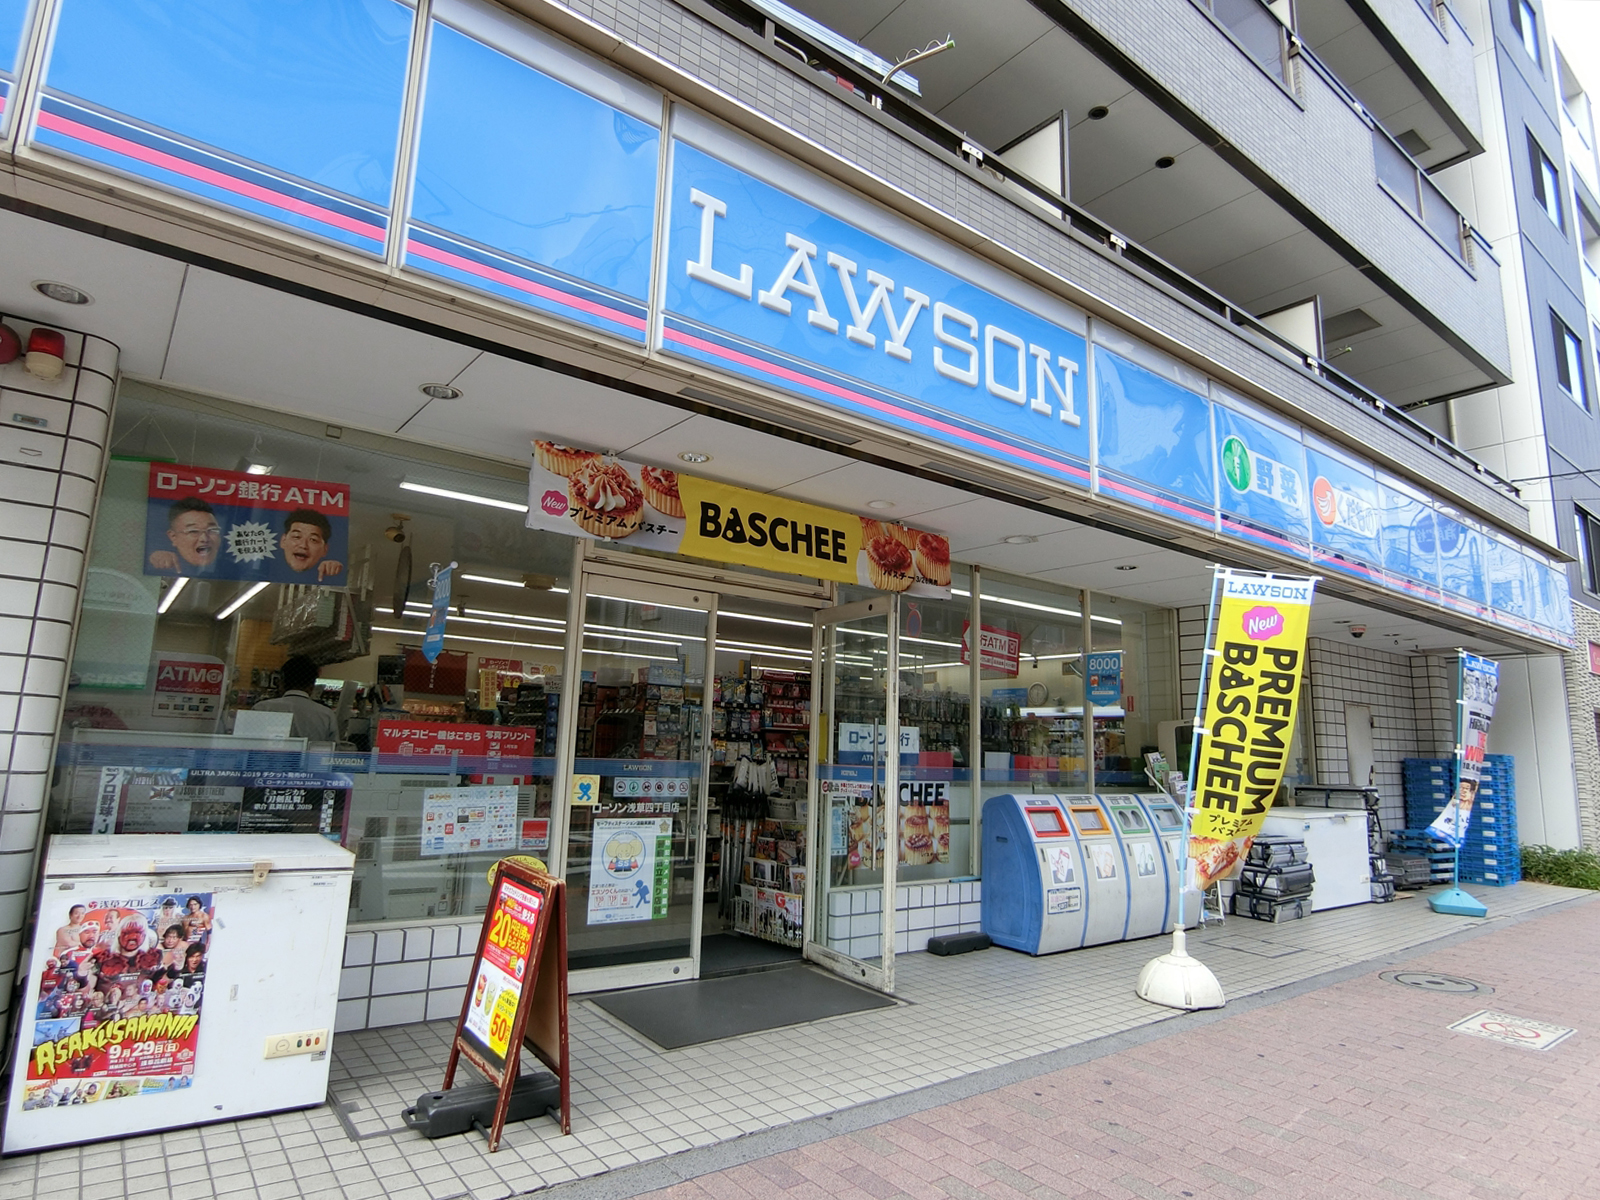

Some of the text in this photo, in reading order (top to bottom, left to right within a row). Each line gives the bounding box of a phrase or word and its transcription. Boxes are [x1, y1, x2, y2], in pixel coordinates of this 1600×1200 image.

[686, 187, 1080, 428] LAWSON
[1255, 456, 1298, 505] 野菜
[543, 496, 566, 511] New
[699, 501, 848, 564] BASCHEE
[1228, 581, 1308, 600] LAWSON
[1248, 614, 1278, 636] New
[1089, 657, 1119, 670] 8000
[159, 666, 207, 682] ATM
[382, 728, 481, 741] マルチコピー機はこちら
[1202, 641, 1258, 814] BASCHEE
[1241, 646, 1299, 816] PREMIUM
[321, 757, 365, 766] AWSON
[592, 802, 680, 814] ローソン浅草四丁目店
[100, 898, 160, 909] 浅草プロレス
[489, 909, 512, 948] 20
[490, 1012, 508, 1042] 50
[36, 1012, 199, 1076] ASAKUSAMANIA
[109, 1040, 180, 1059] 9月29日(日)
